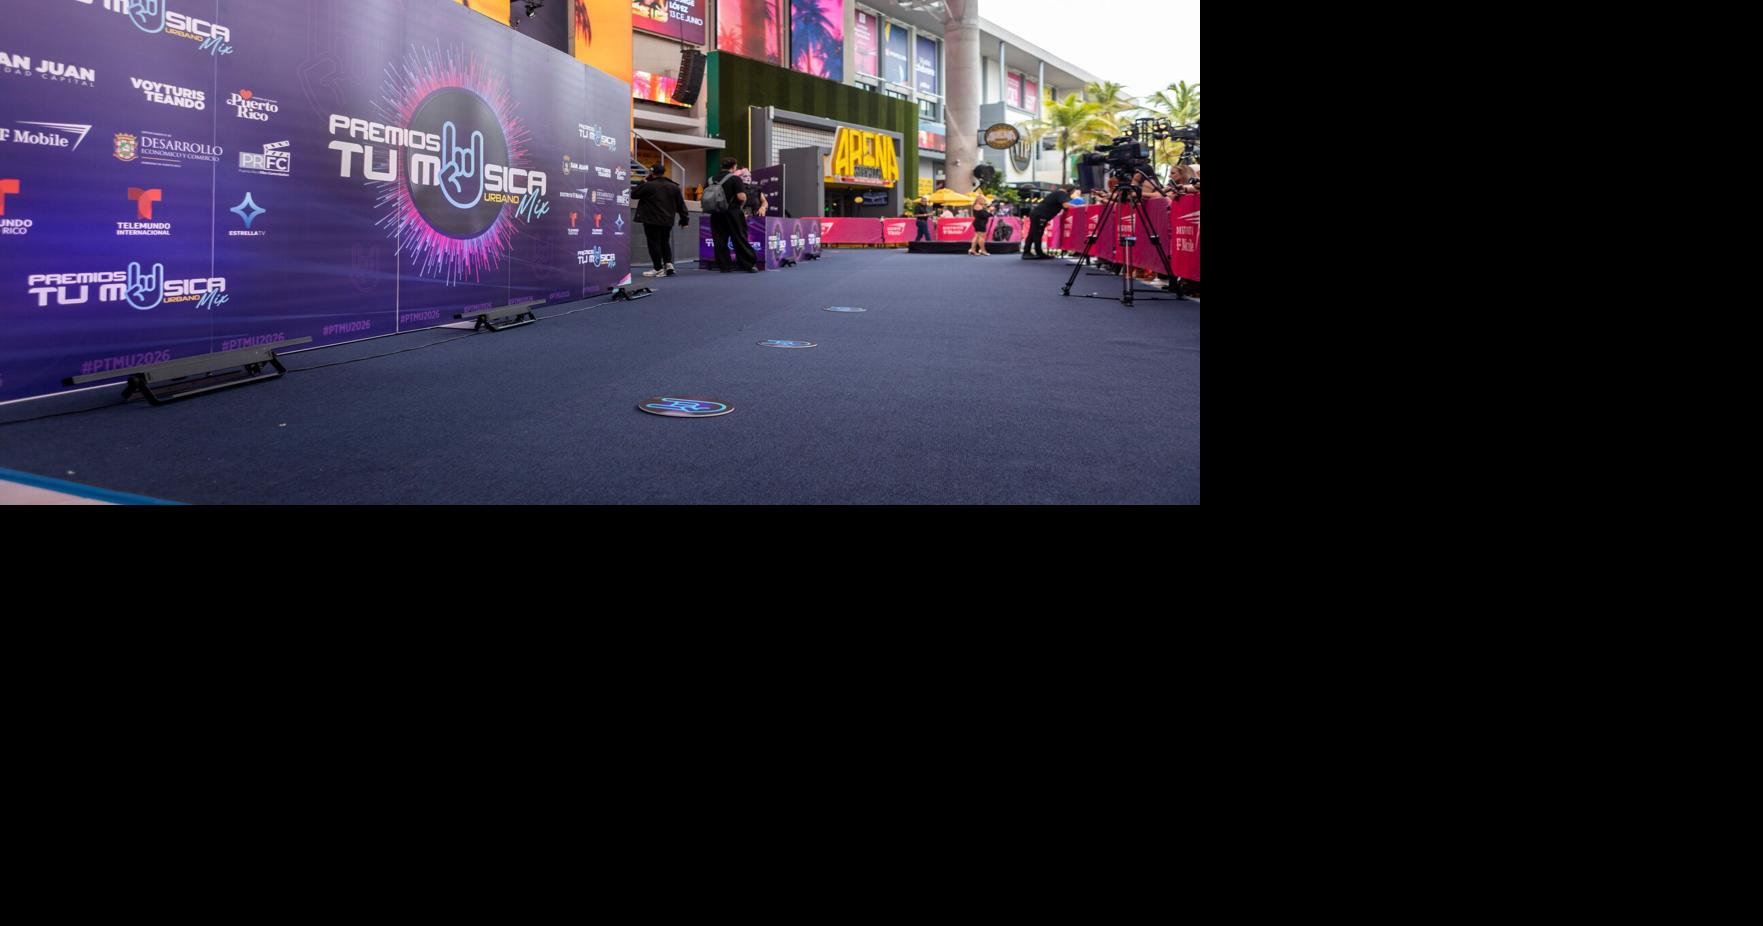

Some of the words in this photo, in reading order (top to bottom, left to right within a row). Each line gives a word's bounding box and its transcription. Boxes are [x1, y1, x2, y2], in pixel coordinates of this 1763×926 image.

[198, 36, 233, 56] Mix
[35, 59, 95, 82] JUAN
[41, 73, 95, 88] CAPITAL
[144, 90, 205, 110] TEANDO
[226, 92, 279, 113] Puerto
[236, 105, 269, 122] Rico
[13, 129, 70, 147] Mobile
[329, 113, 441, 152] PREMIOS
[141, 136, 223, 156] DESARROLLO
[835, 127, 899, 182] ARENA
[328, 139, 398, 182] TU
[484, 192, 520, 205] URBANO
[514, 187, 551, 223] Mix
[2, 227, 27, 235] RICO
[117, 222, 171, 230] TELEMUNDO
[28, 271, 127, 286] PREMIOS
[28, 287, 89, 307] TU
[163, 294, 200, 303] URBANO
[195, 289, 229, 310] Mix
[322, 319, 371, 336] #PTMU2026
